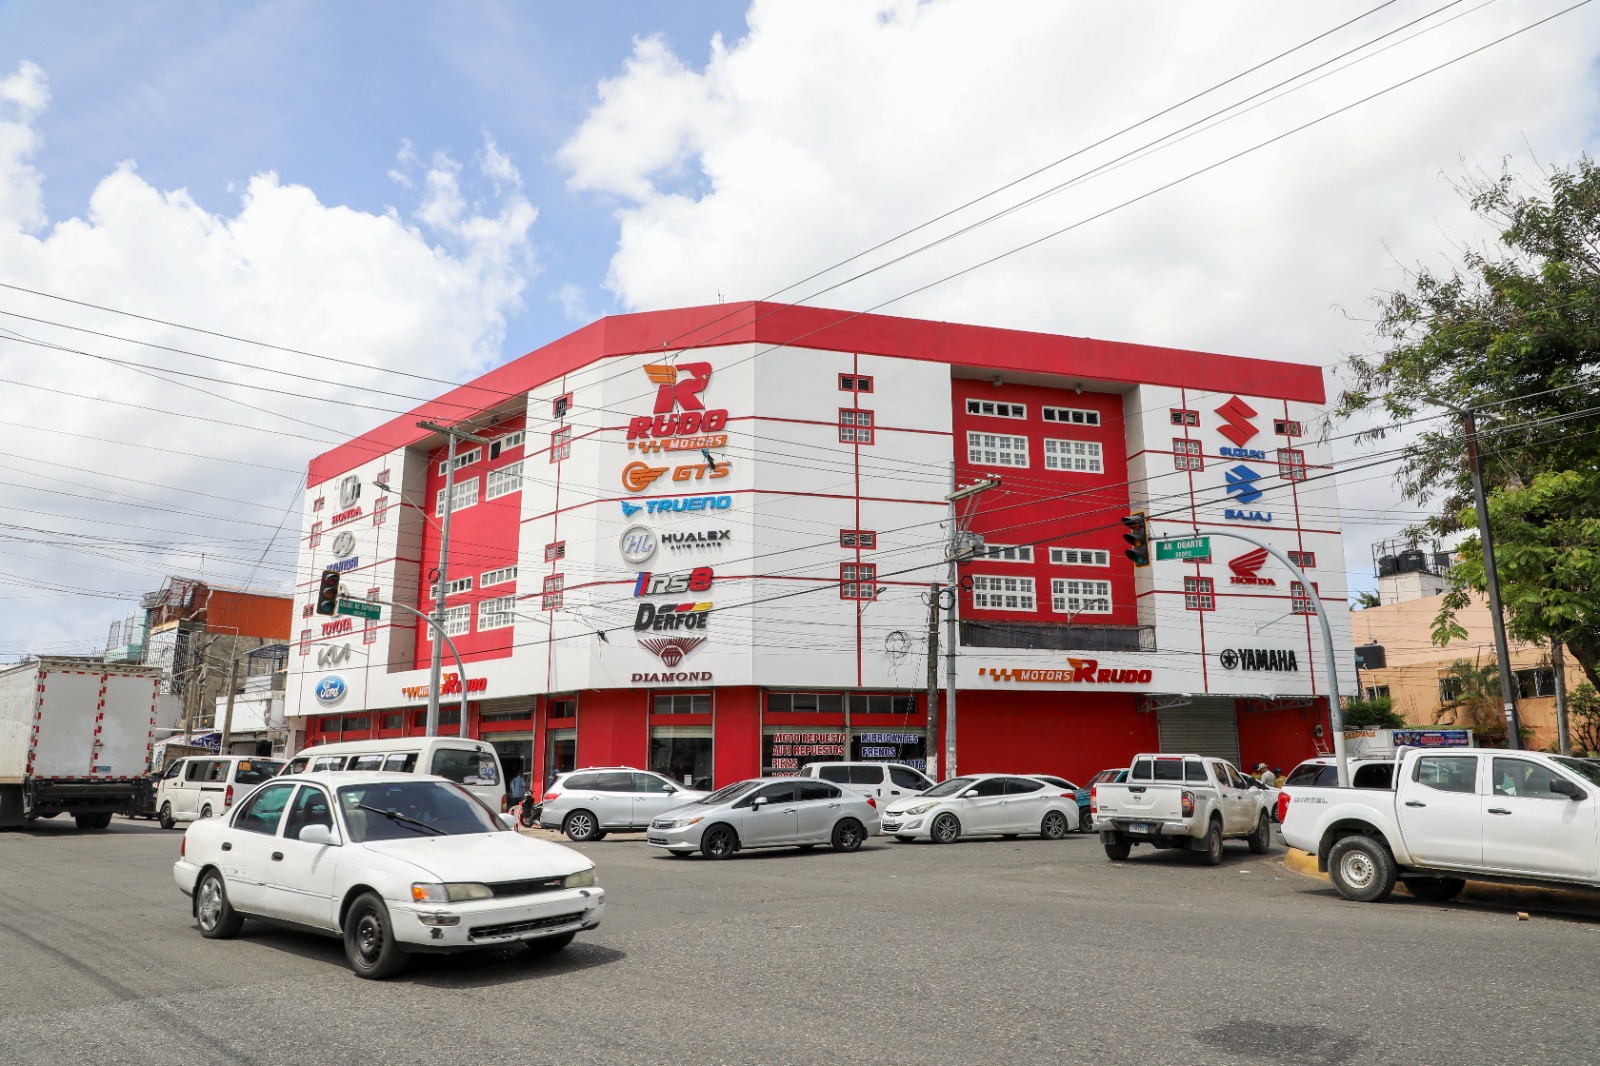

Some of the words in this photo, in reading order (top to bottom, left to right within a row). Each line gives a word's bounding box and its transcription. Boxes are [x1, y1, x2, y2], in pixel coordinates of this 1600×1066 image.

[626, 409, 729, 440] RUDO
[669, 435, 723, 449] MOTORS
[1219, 446, 1266, 460] SUZUKI
[672, 462, 731, 482] GTS
[646, 496, 731, 514] TRUENO
[1224, 509, 1272, 522] BAJAJ
[661, 529, 731, 543] HUALEX
[1177, 539, 1204, 549] DUARTE
[1229, 576, 1276, 586] HONDA
[321, 617, 352, 636] TOYOTA
[1238, 649, 1298, 672] YAMAHA
[631, 671, 713, 683] DIAMOND
[1020, 670, 1071, 681] MOTORS
[1097, 669, 1153, 683] RUDO
[320, 679, 340, 698] Ford
[774, 733, 799, 743] MOTO
[860, 732, 919, 744] LUBRICANTES
[772, 745, 793, 756] AUTO
[794, 744, 845, 756] REPUESTOS
[862, 747, 896, 758] FRENOS
